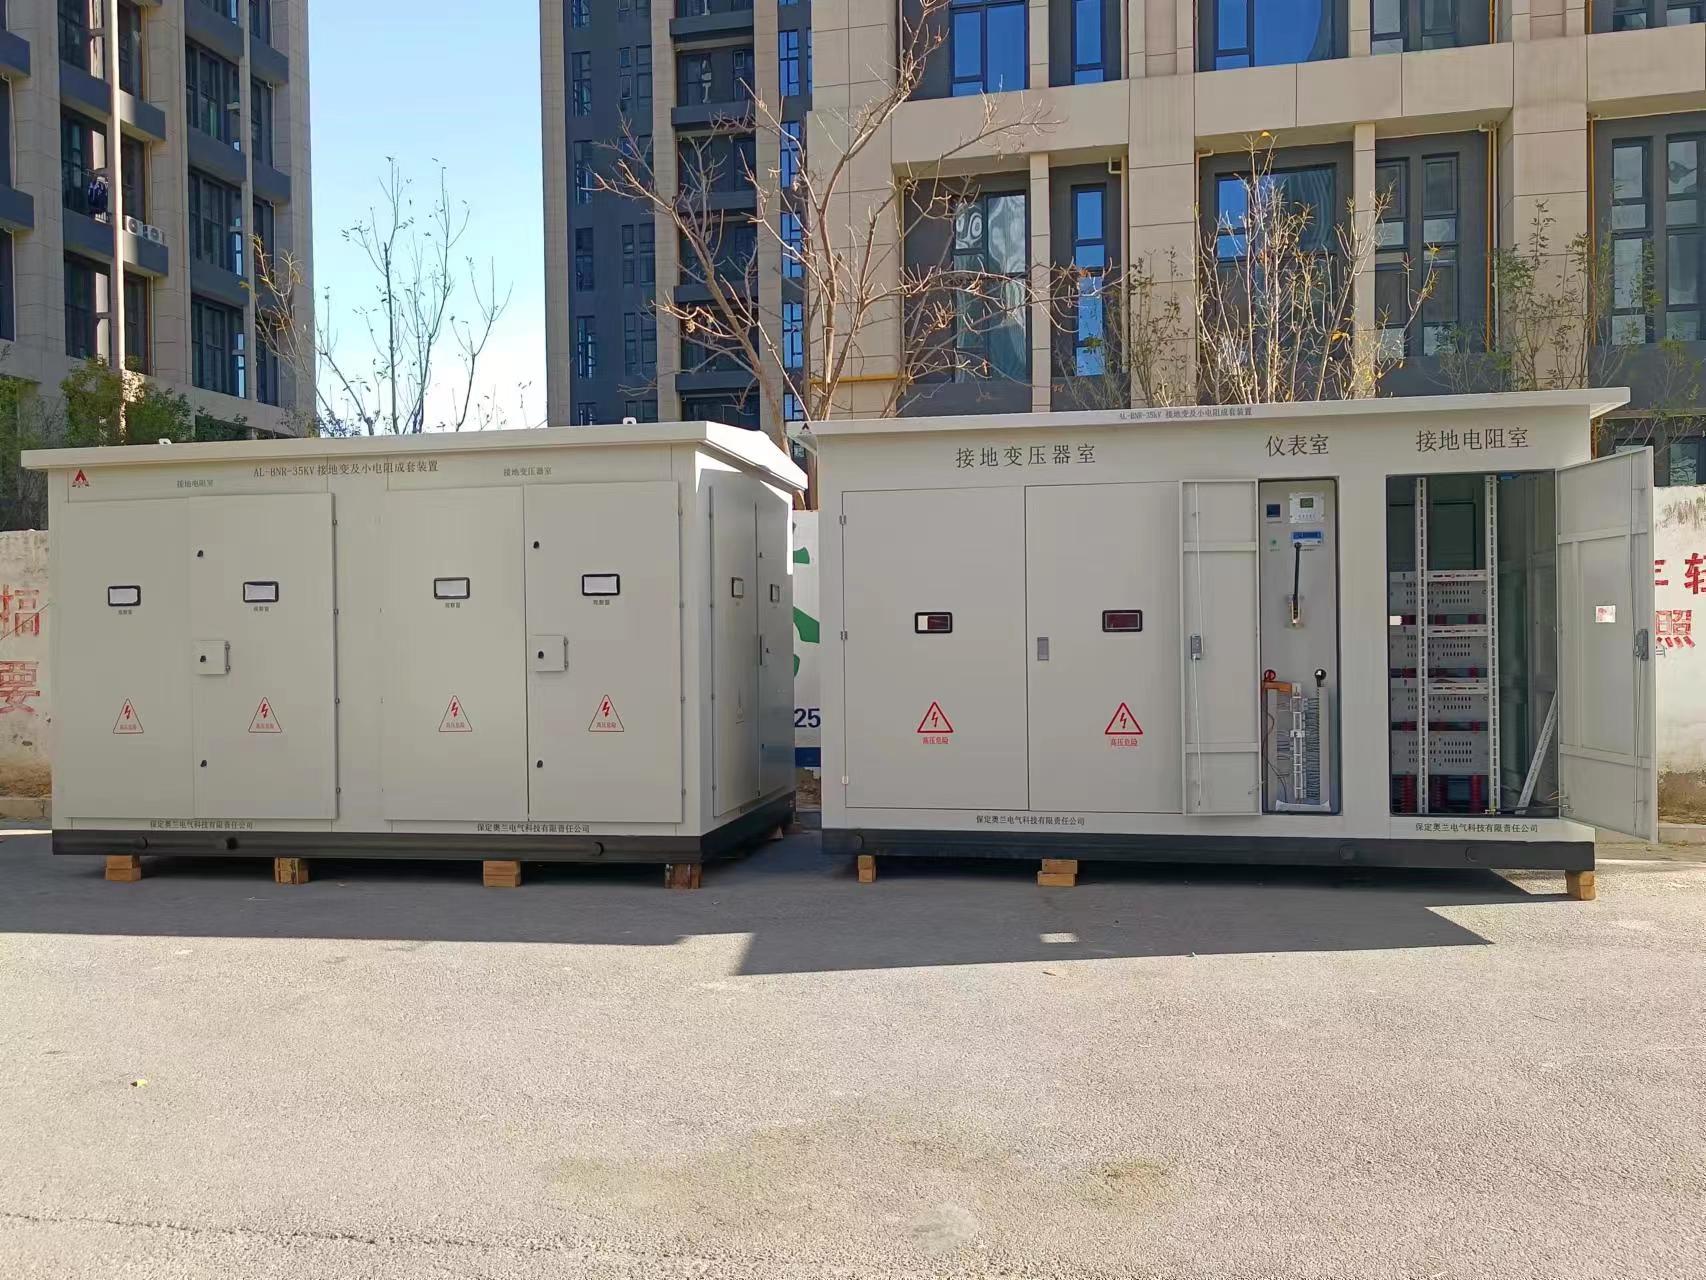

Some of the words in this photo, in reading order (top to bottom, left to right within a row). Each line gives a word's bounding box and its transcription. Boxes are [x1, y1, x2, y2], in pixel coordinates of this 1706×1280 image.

[1265, 433, 1329, 457] 仪表室
[1415, 428, 1529, 452] 接地电阻室
[317, 460, 439, 476] 接地变及小电阻成套装置
[955, 443, 1096, 469] 接地变压器室
[794, 708, 821, 728] 25
